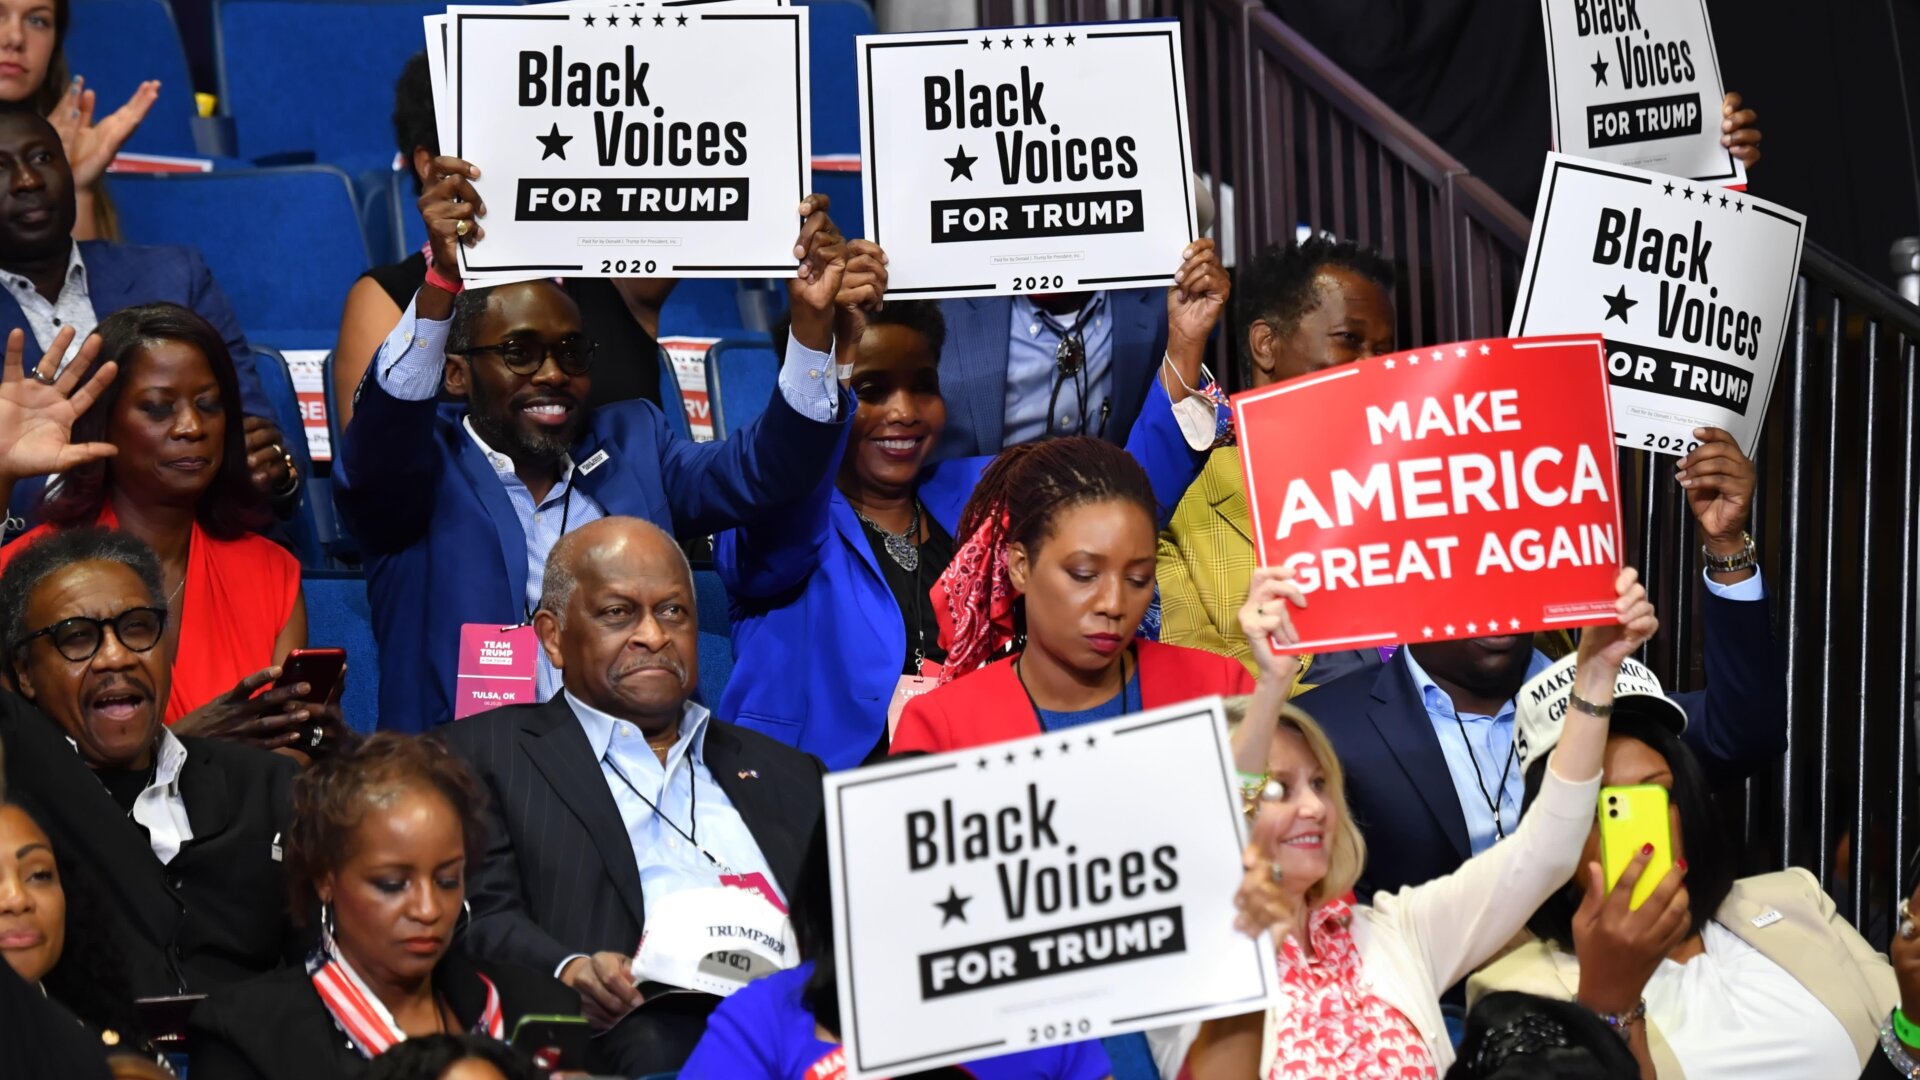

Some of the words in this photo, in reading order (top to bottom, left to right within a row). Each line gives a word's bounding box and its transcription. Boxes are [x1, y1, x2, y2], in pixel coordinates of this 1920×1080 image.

[1573, 0, 1642, 37] Black
[518, 45, 650, 107] Black
[1616, 29, 1695, 89] Voices
[924, 66, 1046, 130] Black
[1593, 111, 1630, 139] FOR
[1635, 102, 1697, 133] TRUMP
[593, 106, 748, 167] Voices
[995, 124, 1138, 185] Voices
[528, 187, 602, 212] FOR
[616, 187, 739, 212] TRUMP
[942, 206, 1009, 233] FOR
[1021, 200, 1134, 229] TRUMP
[600, 260, 657, 273] 2020
[1593, 207, 1712, 284] Black
[1013, 275, 1064, 291] 2020
[1659, 281, 1762, 360] Voices
[1607, 351, 1657, 382] OR
[1670, 361, 1748, 404] TRUMP
[1365, 389, 1522, 446] MAKE
[1643, 433, 1700, 453] 2020
[1275, 444, 1610, 540] AMERICA
[1283, 536, 1460, 594] GREAT
[1475, 523, 1617, 576] AGAIN
[480, 648, 513, 657] TRUMP
[483, 640, 511, 649] TEAM
[472, 691, 501, 700] TULSA,
[503, 692, 516, 700] OK
[1531, 664, 1577, 706] MAKE
[1618, 662, 1657, 687] RICA
[905, 782, 1059, 872] Black
[996, 844, 1180, 922] Voices
[931, 947, 1016, 990] FOR
[1030, 916, 1174, 970] TRUMP
[1028, 1018, 1092, 1043] 2020
